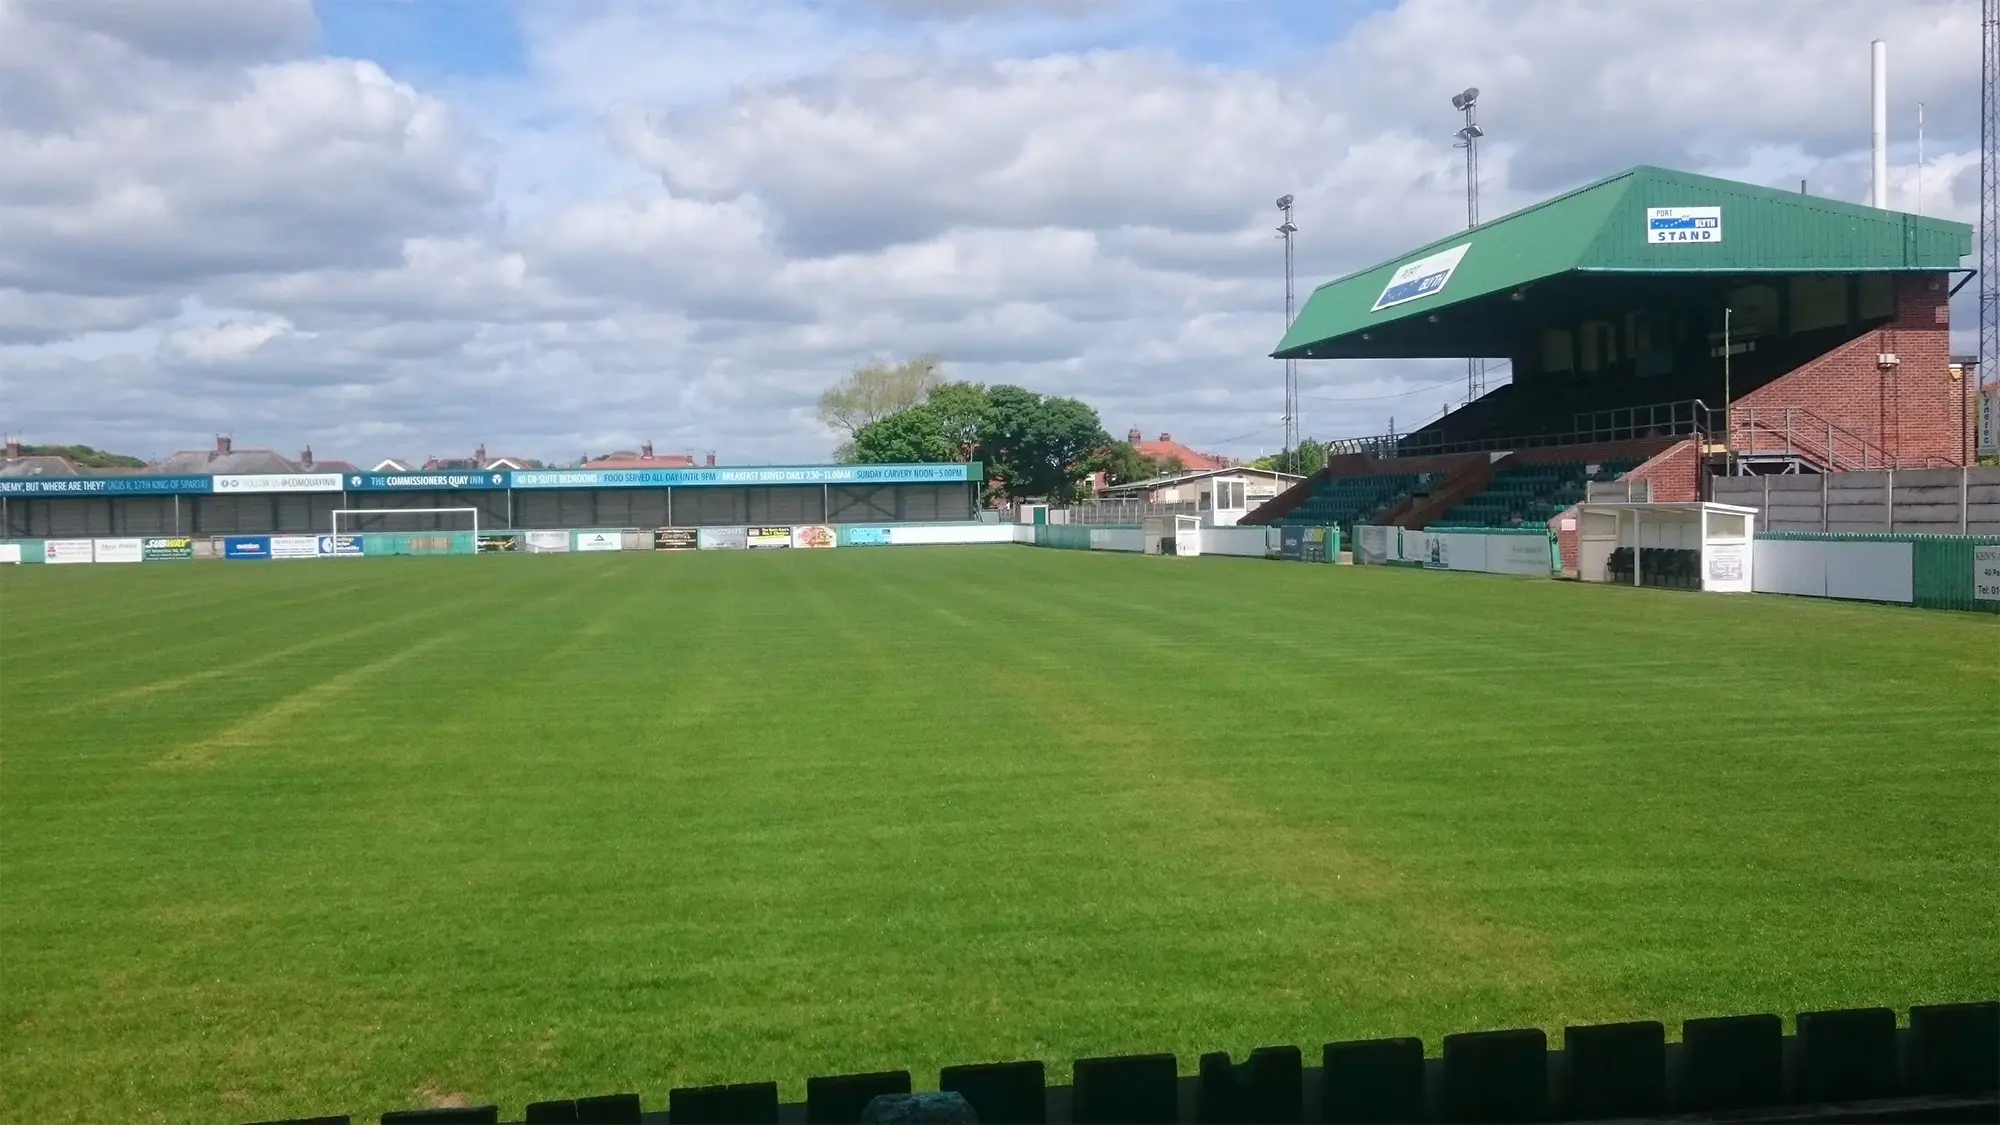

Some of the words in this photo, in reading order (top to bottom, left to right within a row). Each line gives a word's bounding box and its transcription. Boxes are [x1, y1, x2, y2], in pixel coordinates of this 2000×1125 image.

[1656, 209, 1673, 217] PORT
[1658, 230, 1711, 241] STAND
[518, 475, 526, 484] 40
[527, 474, 557, 484] EN-SUITE
[559, 473, 597, 484] BEDROOMS
[604, 473, 623, 482] FOOD
[625, 473, 650, 482] SERVED
[653, 472, 663, 482] ALL
[665, 472, 678, 481] DAY
[680, 472, 699, 481] UNTIL
[701, 472, 716, 481] 9PM
[722, 471, 758, 481] BREAKFAST
[759, 470, 785, 480] SERVED
[786, 470, 804, 480] DAILY
[857, 469, 881, 479] SUNDAY
[883, 469, 912, 478] CARVERY
[26, 481, 39, 491] BUT
[68, 481, 82, 490] ARE
[134, 480, 151, 489] 17TH
[152, 480, 169, 489] KING
[169, 480, 179, 489] OF
[180, 479, 208, 489] SPARTA)
[281, 478, 336, 487] @COMQUAYINN
[371, 476, 385, 485] THE
[387, 475, 447, 485] COMMISSIONERS
[449, 475, 468, 487] QUAY
[470, 475, 484, 484] INN
[145, 538, 190, 548] SUBWAY
[1984, 568, 1992, 577] 40
[1978, 585, 1990, 595] Tel:
